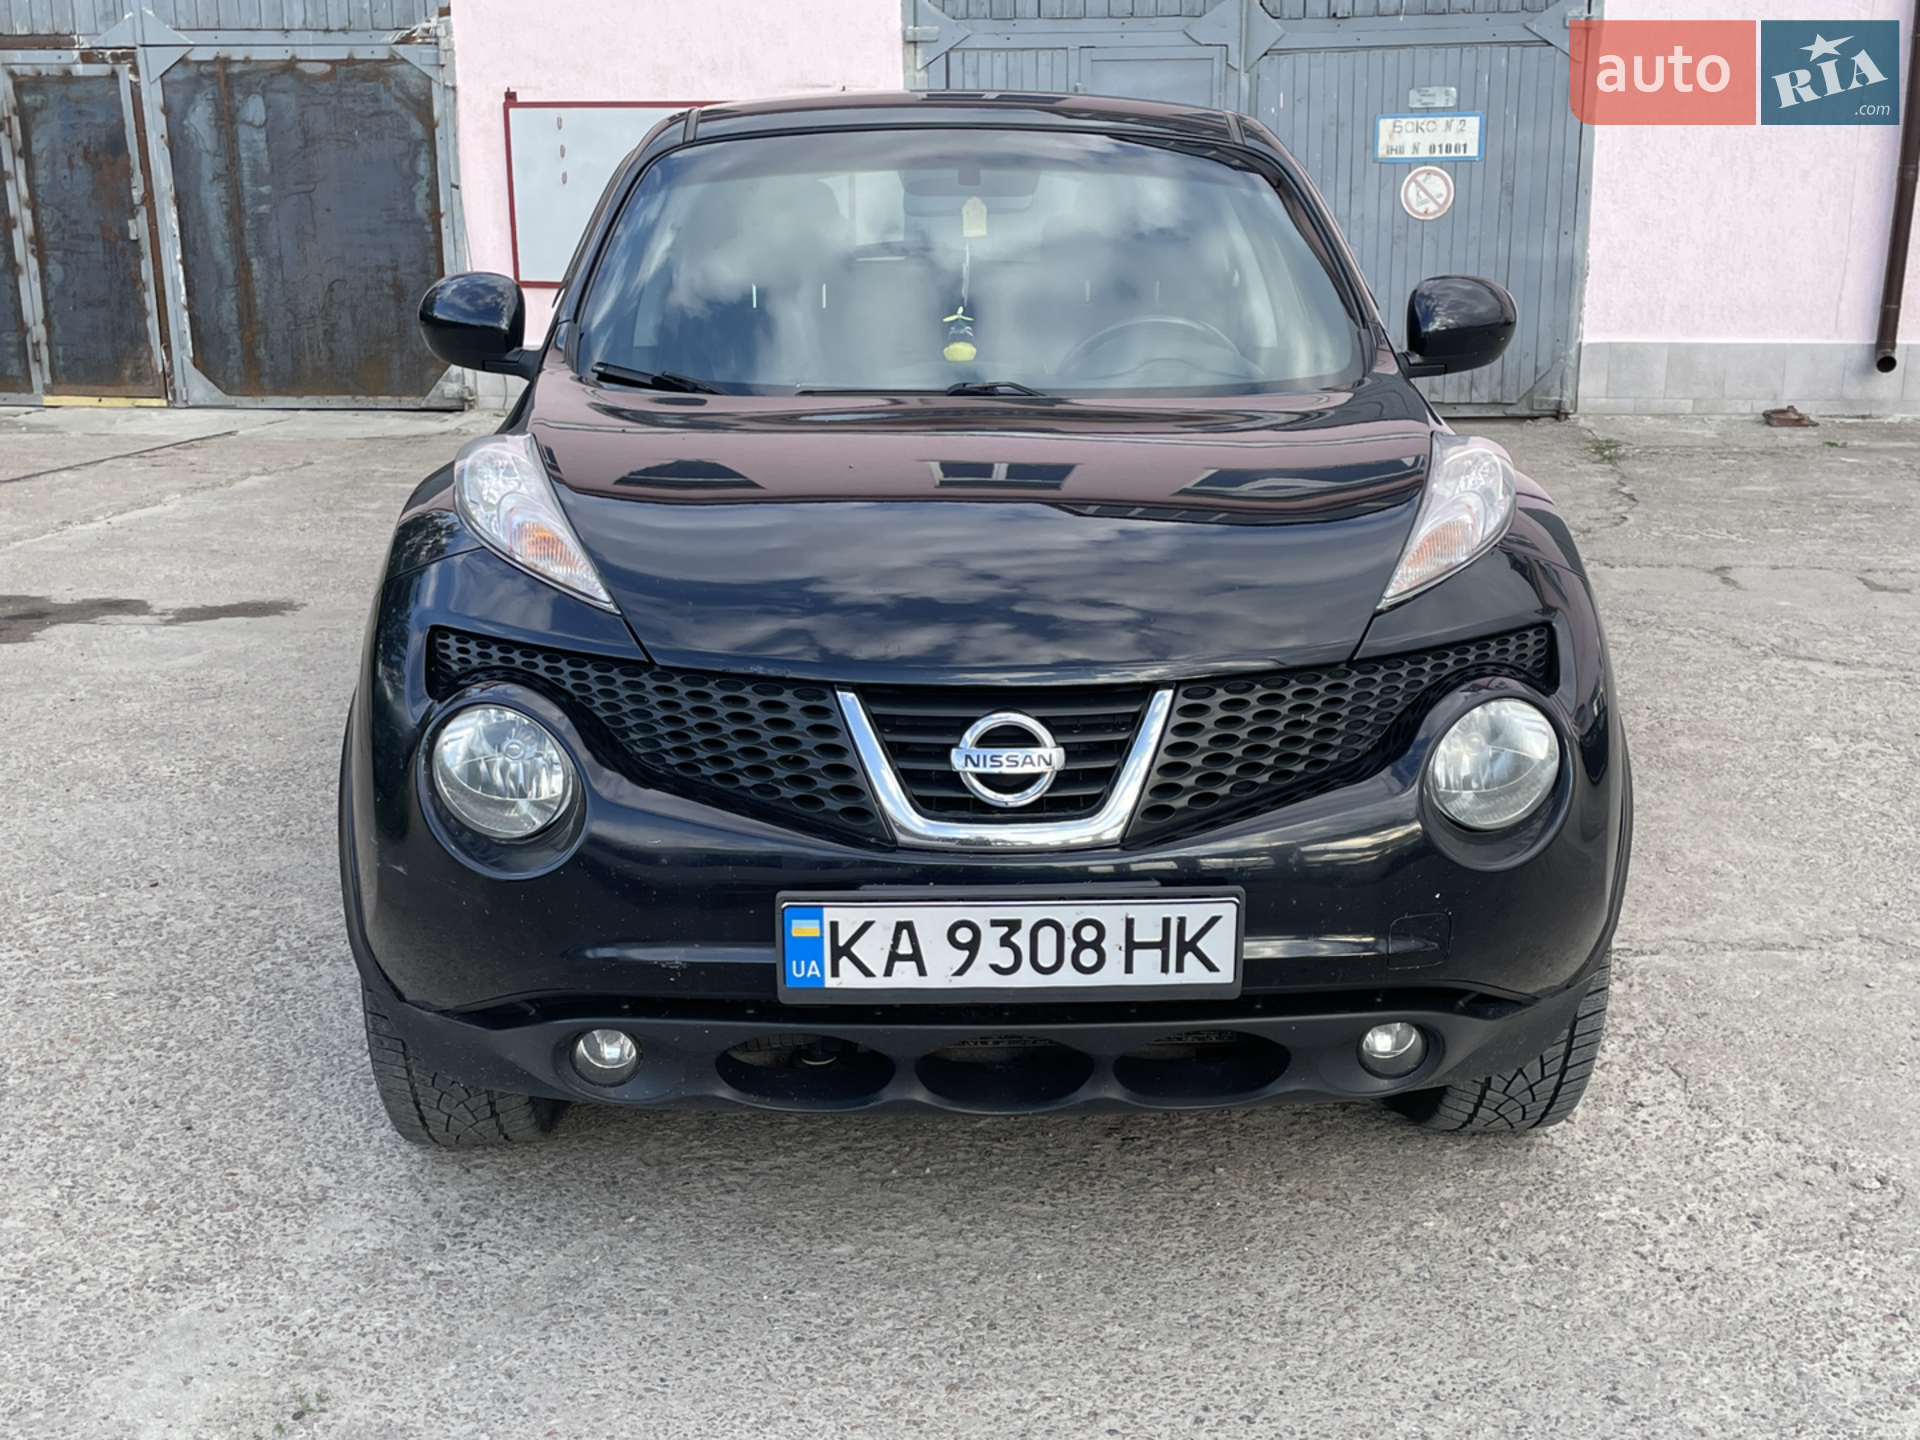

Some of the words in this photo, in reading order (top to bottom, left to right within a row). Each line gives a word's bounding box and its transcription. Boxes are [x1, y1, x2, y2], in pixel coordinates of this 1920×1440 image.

[1459, 119, 1467, 132] 2
[1429, 142, 1468, 154] 01001
[964, 753, 1053, 768] NISSAN
[829, 920, 928, 978] KA
[946, 917, 1108, 977] 9308
[1123, 915, 1224, 975] HK
[791, 962, 822, 978] UA
